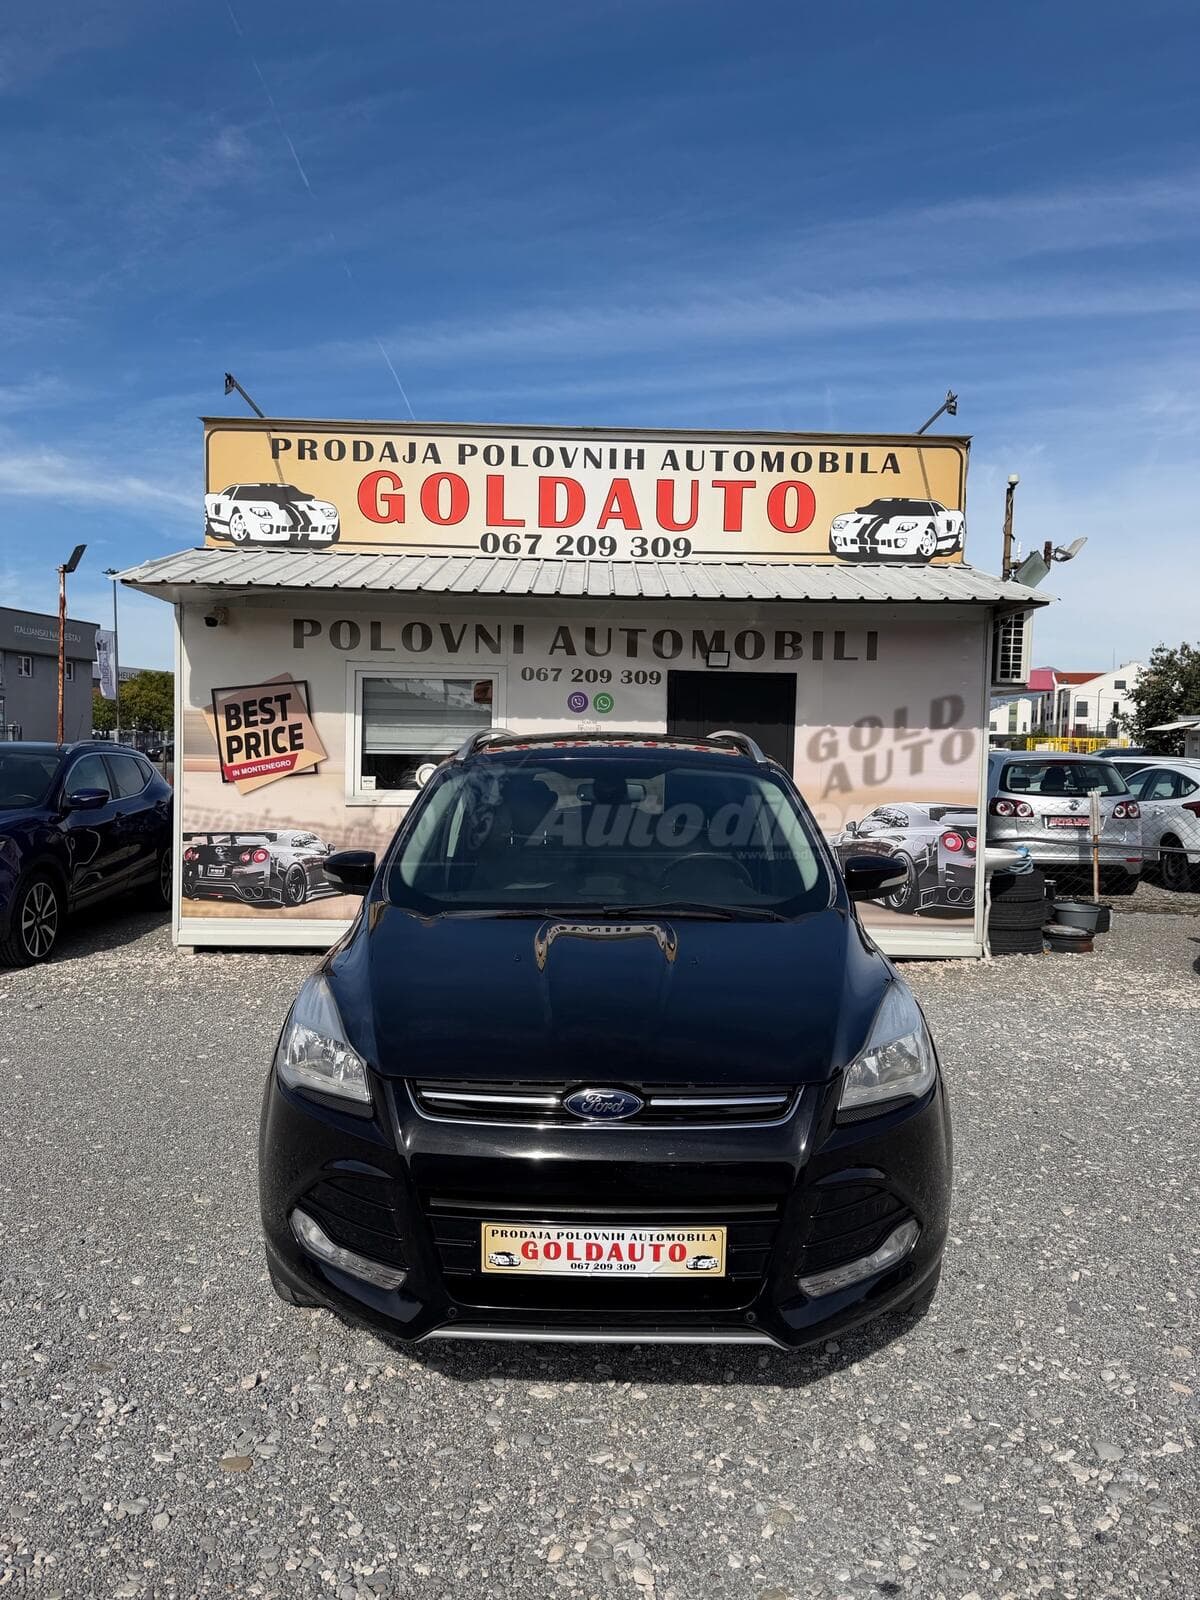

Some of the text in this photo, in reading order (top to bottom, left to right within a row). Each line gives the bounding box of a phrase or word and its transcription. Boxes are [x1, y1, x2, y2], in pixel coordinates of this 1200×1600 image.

[271, 438, 901, 474] PRODAJA POLOVNIH AUTOMOBILA
[357, 470, 817, 534] GOLDAUTO
[480, 532, 692, 559] 067 209 309
[293, 618, 878, 661] POLOVNI AUTOMOBILI
[521, 667, 662, 685] 067 209 309
[224, 693, 291, 732] BEST
[226, 722, 304, 763] PRICE
[806, 694, 965, 763] GOLD
[241, 760, 291, 775] MONTENEGRO
[820, 730, 976, 799] AUTO
[581, 1093, 625, 1112] Ford
[491, 1229, 717, 1242] PRODAJA POLOVNIH AUTOMOBILA
[520, 1240, 688, 1263] GOLDAUTO
[570, 1262, 637, 1271] 067 209 309
